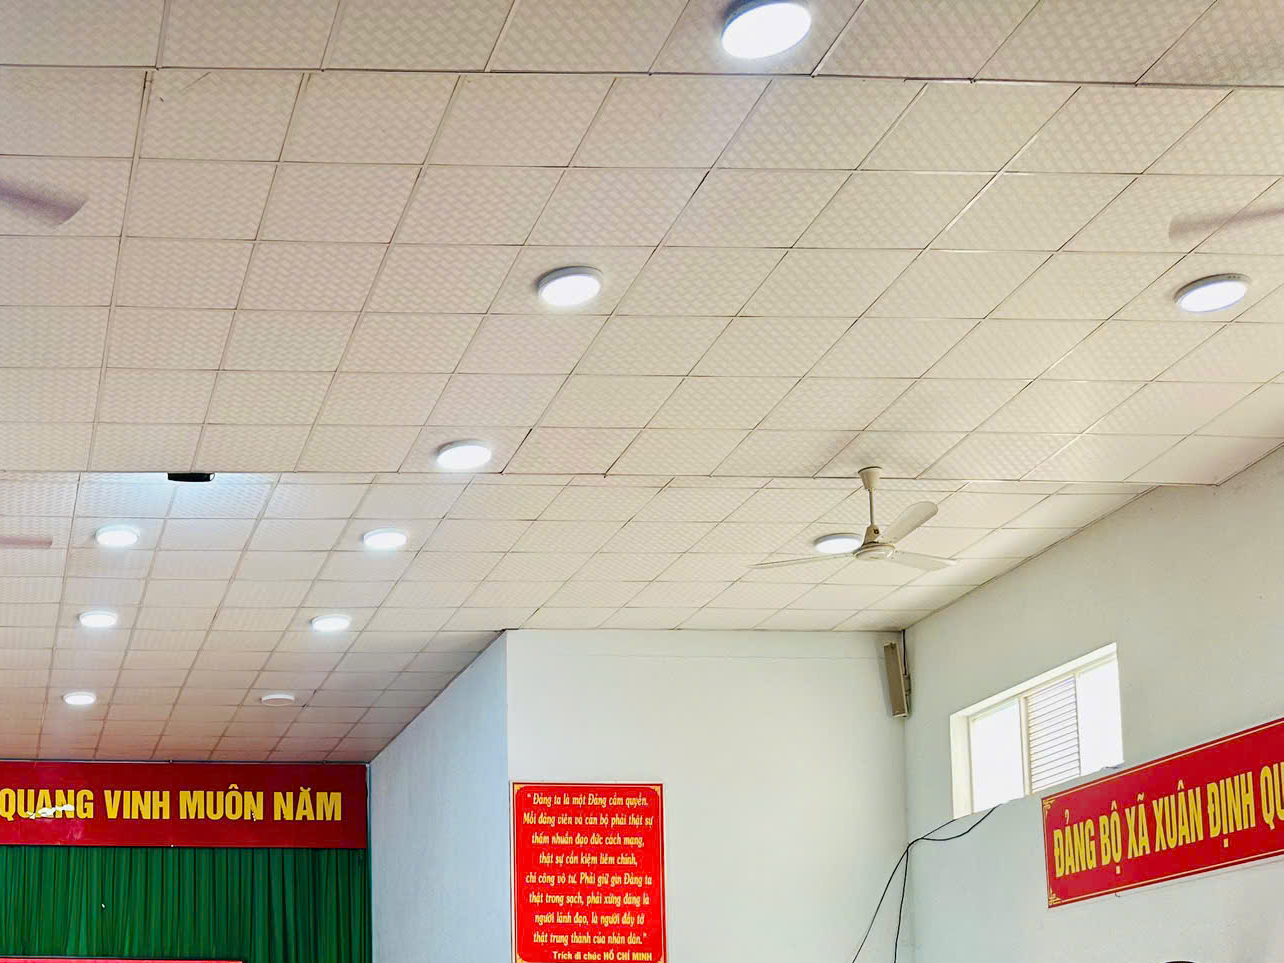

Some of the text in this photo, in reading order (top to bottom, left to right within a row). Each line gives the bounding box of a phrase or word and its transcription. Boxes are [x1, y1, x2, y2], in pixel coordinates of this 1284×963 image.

[103, 789, 171, 820] VINH
[179, 783, 264, 821] MUÔN
[273, 786, 342, 822] NĂM
[1052, 809, 1097, 878] ĐẢNG
[1099, 800, 1122, 875] BỘ
[1125, 792, 1151, 860] XÃ
[1152, 779, 1204, 852] XUÂN
[1207, 771, 1256, 848] ĐỊNH
